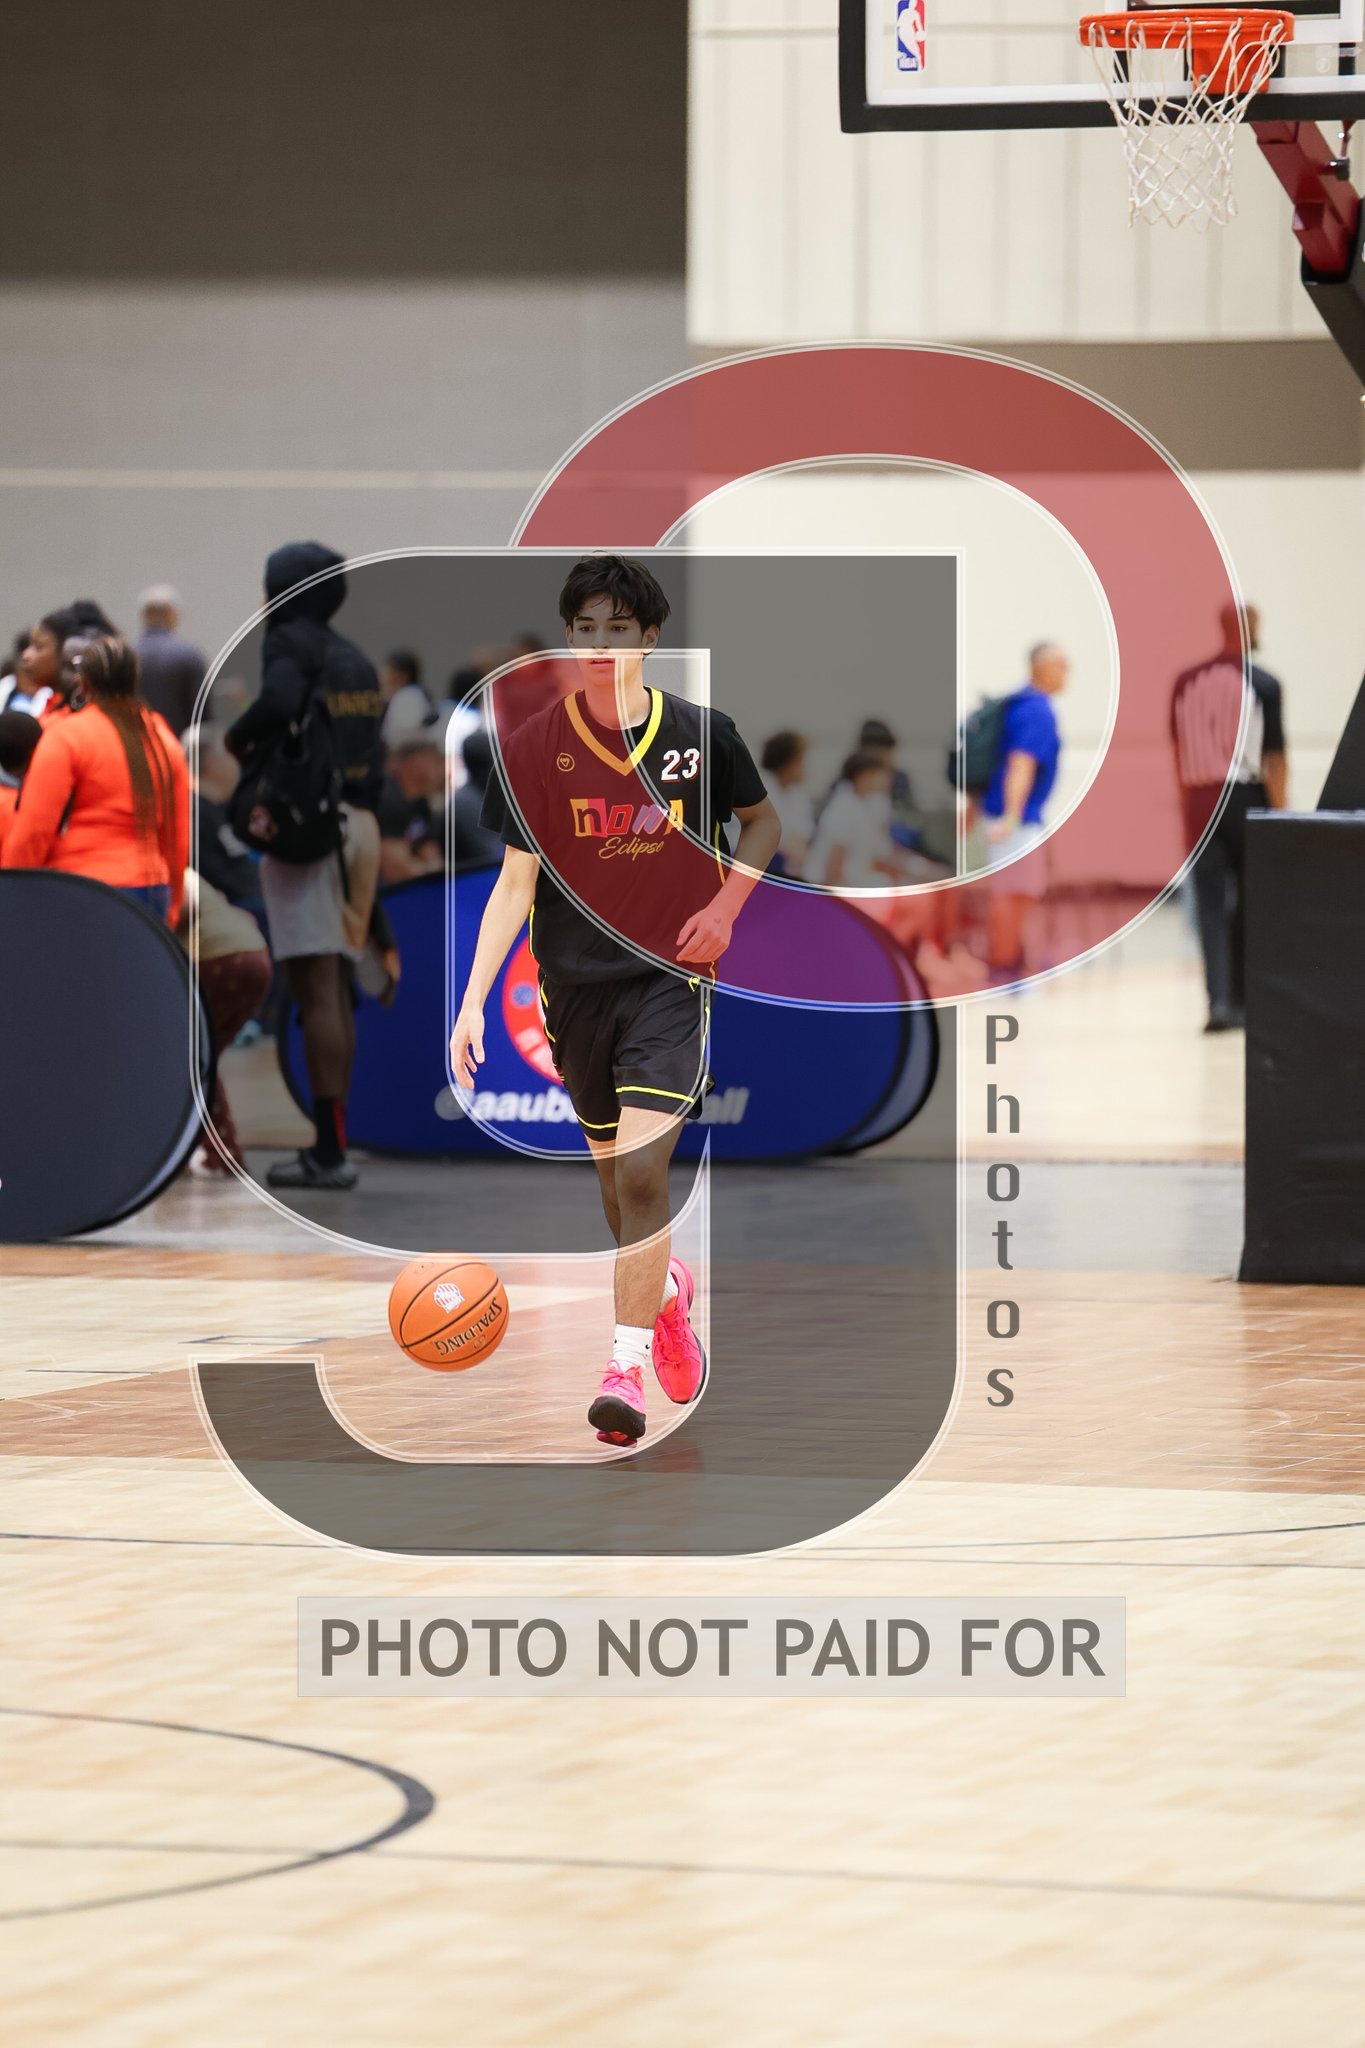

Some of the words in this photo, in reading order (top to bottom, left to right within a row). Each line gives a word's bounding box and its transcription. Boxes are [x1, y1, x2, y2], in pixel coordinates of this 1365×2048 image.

[661, 748, 701, 782] 23
[598, 836, 665, 861] Eclipse
[434, 1297, 502, 1356] SPALDING
